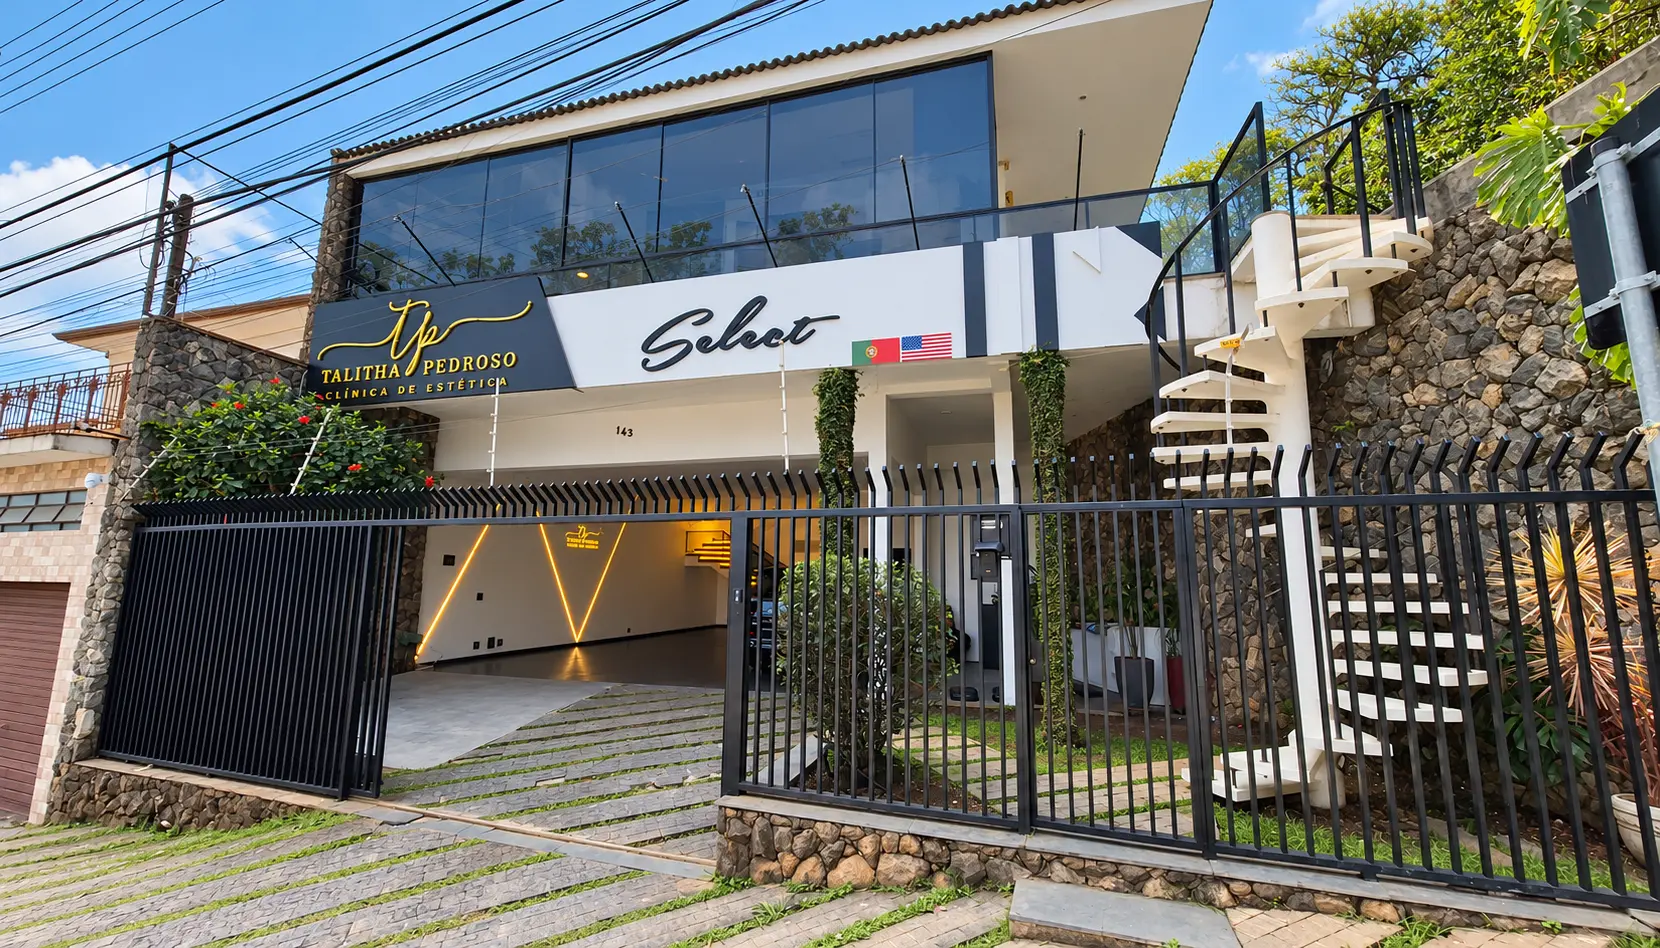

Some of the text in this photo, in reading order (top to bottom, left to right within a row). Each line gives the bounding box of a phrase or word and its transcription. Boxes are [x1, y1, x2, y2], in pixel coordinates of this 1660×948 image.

[641, 294, 840, 372] Select
[321, 351, 517, 383] TALITHA PEDROSO
[326, 377, 507, 400] CLÍNICA DE ESTÉTICA
[616, 425, 633, 438] 143
